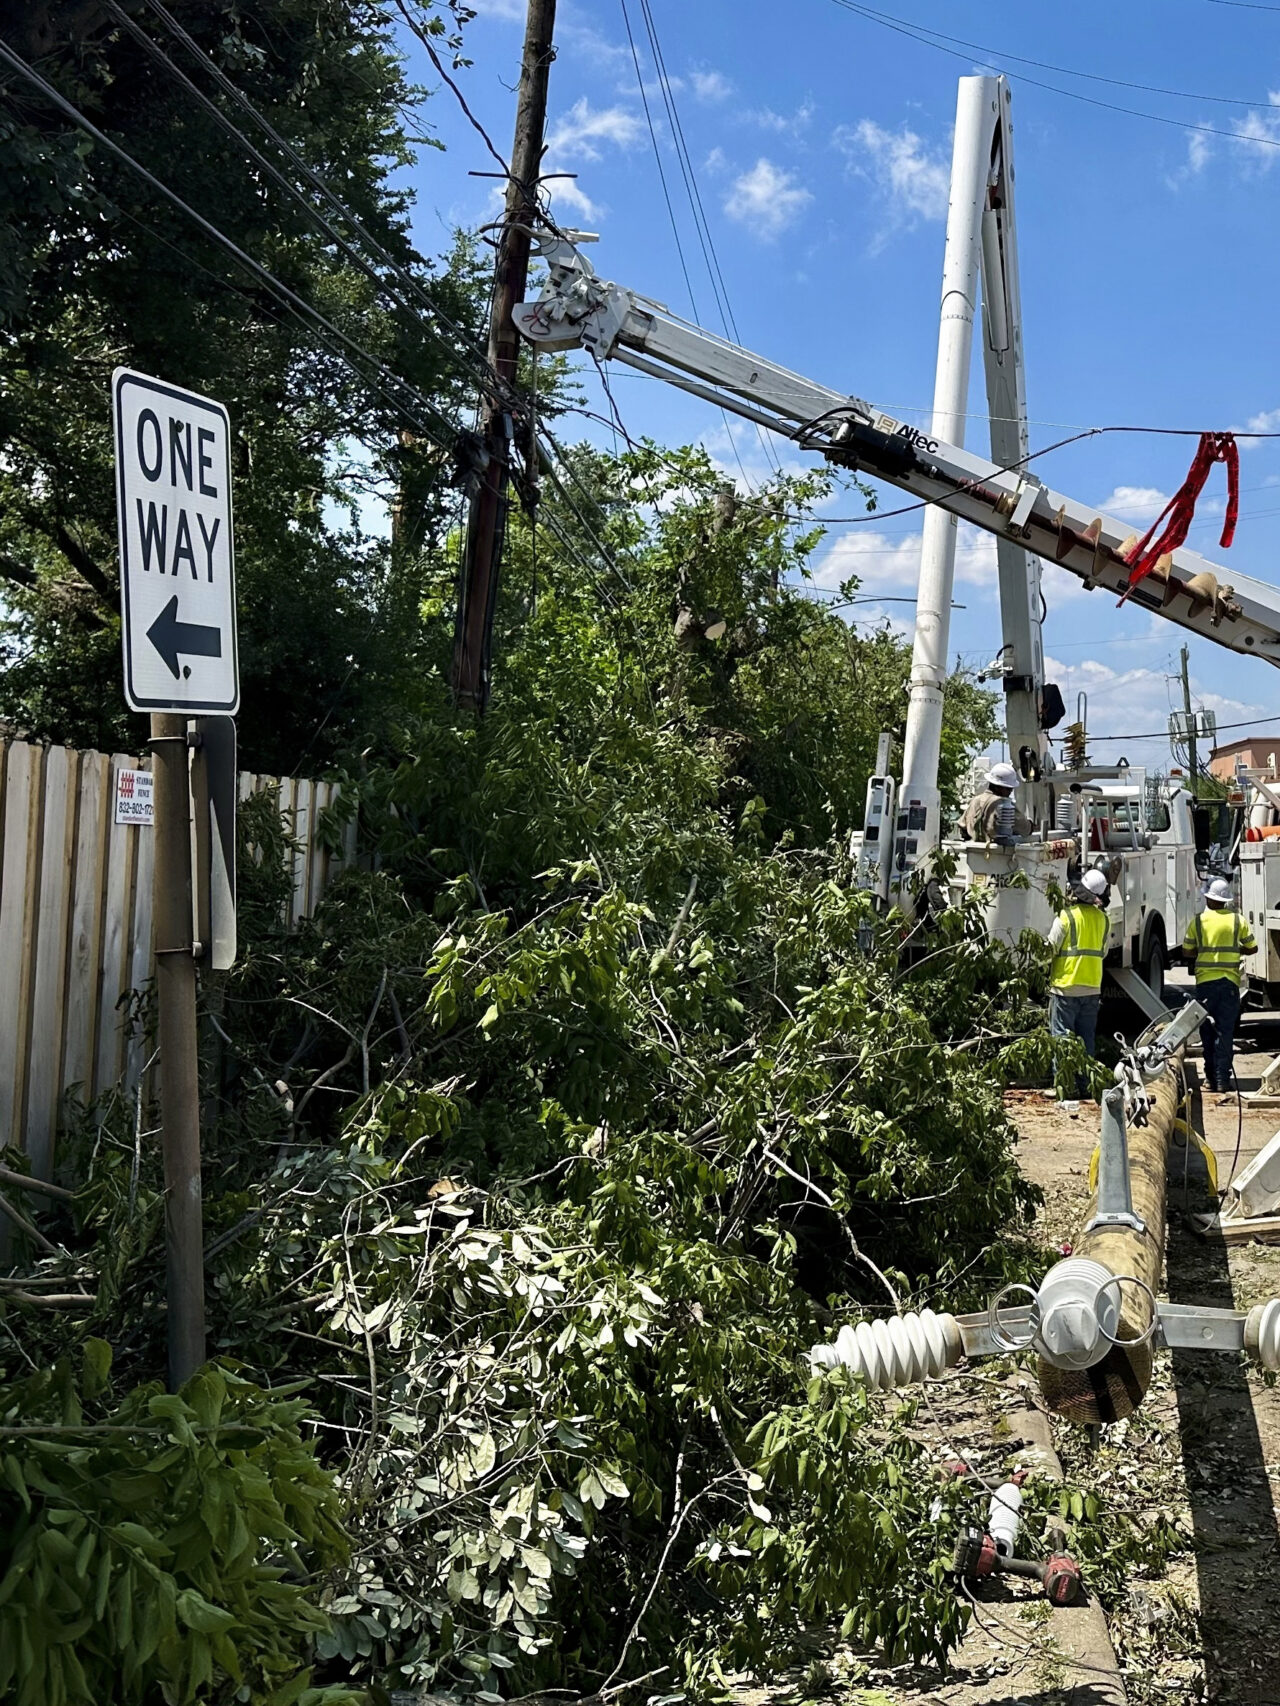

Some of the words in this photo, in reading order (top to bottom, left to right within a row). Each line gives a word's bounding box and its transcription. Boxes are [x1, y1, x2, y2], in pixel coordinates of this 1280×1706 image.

[136, 408, 218, 499] ONE
[895, 424, 939, 454] Altec
[135, 498, 221, 583] WAY
